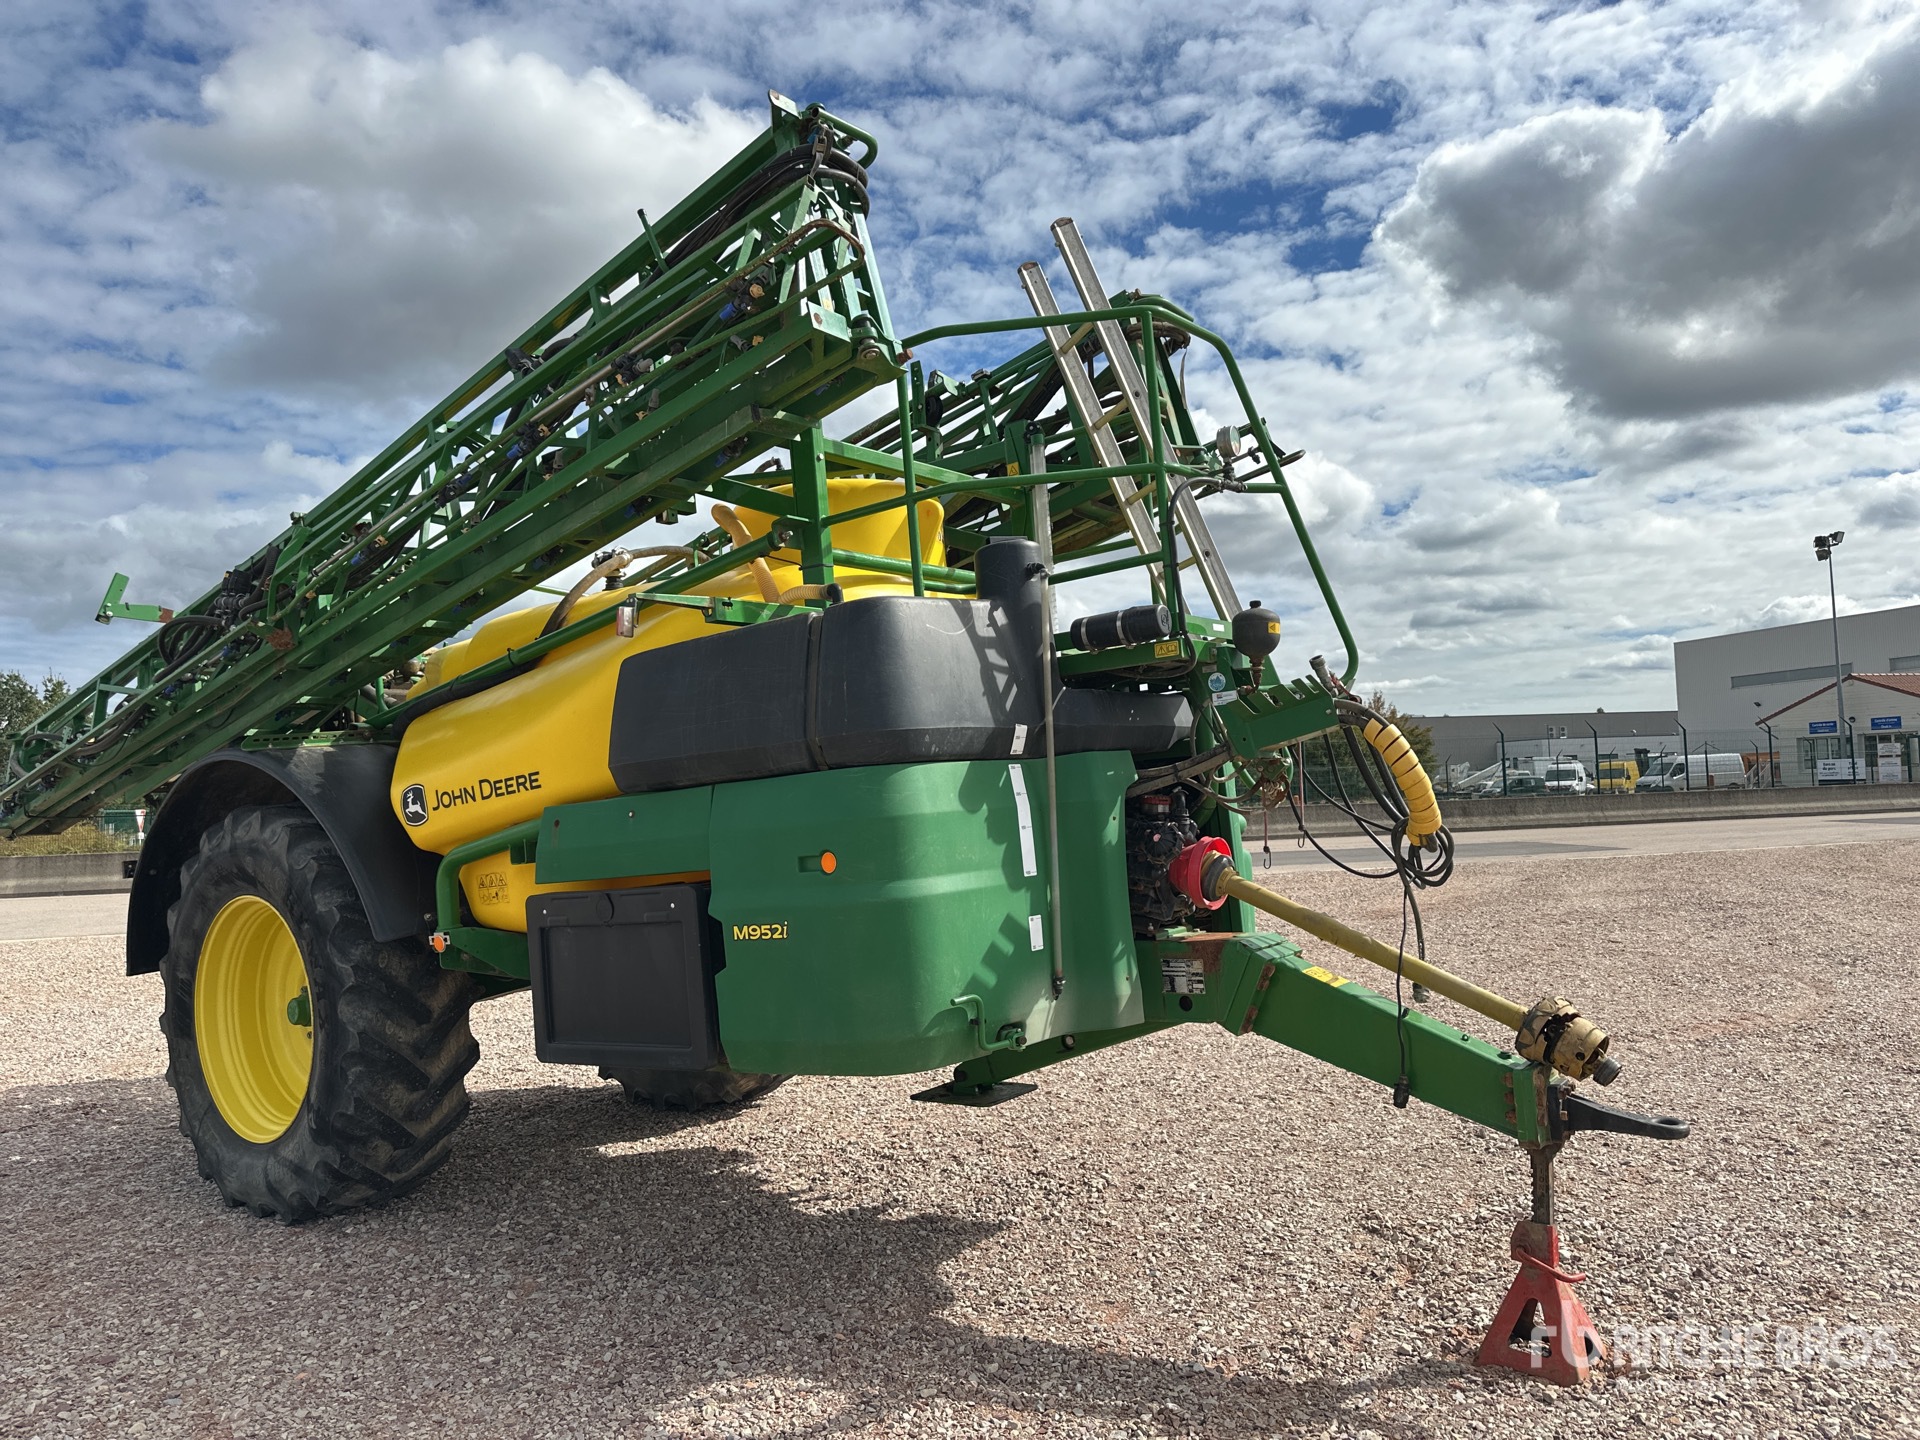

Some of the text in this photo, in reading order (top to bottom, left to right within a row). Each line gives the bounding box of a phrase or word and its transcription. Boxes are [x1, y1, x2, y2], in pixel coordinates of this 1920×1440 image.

[432, 771, 541, 811] JOHN DEERE
[733, 921, 788, 940] M952i
